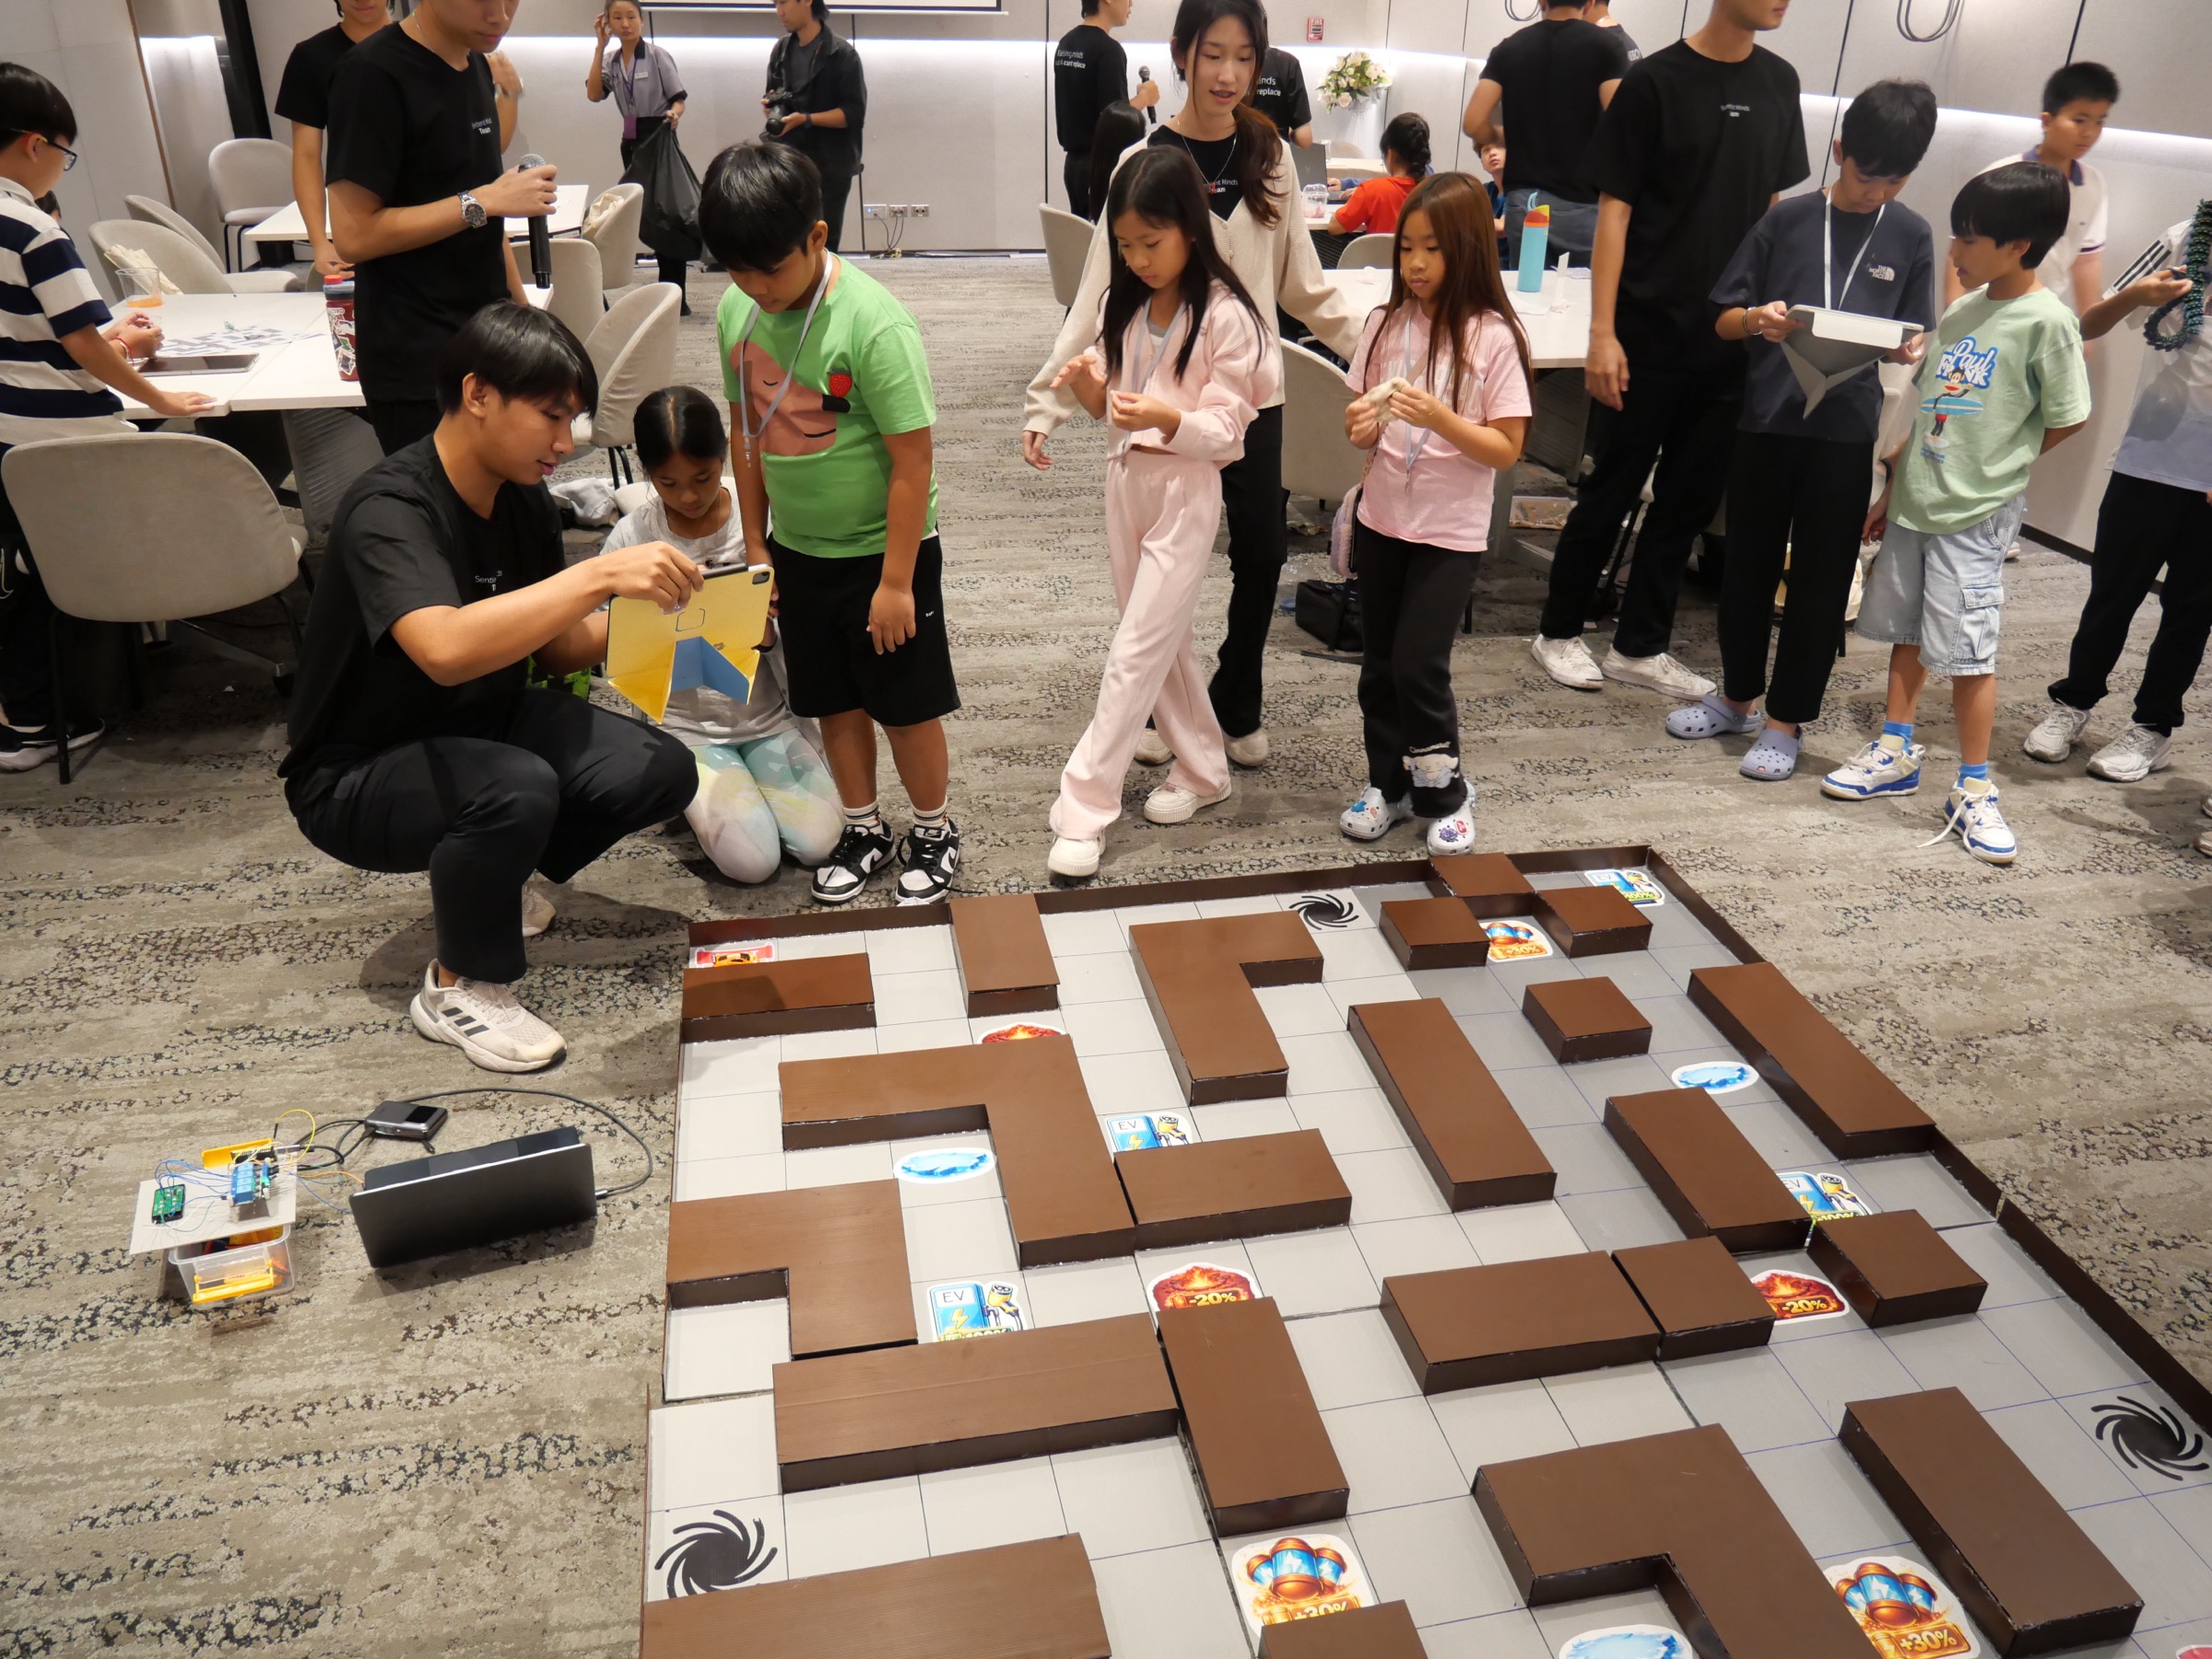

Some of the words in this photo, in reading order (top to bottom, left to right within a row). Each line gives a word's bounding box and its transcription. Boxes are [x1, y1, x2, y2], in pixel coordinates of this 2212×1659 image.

[1257, 76, 1277, 86] inds
[1256, 87, 1281, 97] replace
[1949, 337, 1994, 372] Paul
[1936, 352, 1990, 387] FRNK
[1118, 1120, 1137, 1131] EV
[942, 1290, 965, 1303] EV
[1189, 1292, 1237, 1307] -20%
[1782, 1299, 1827, 1313] -20%
[1900, 1628, 1958, 1653] +30%
